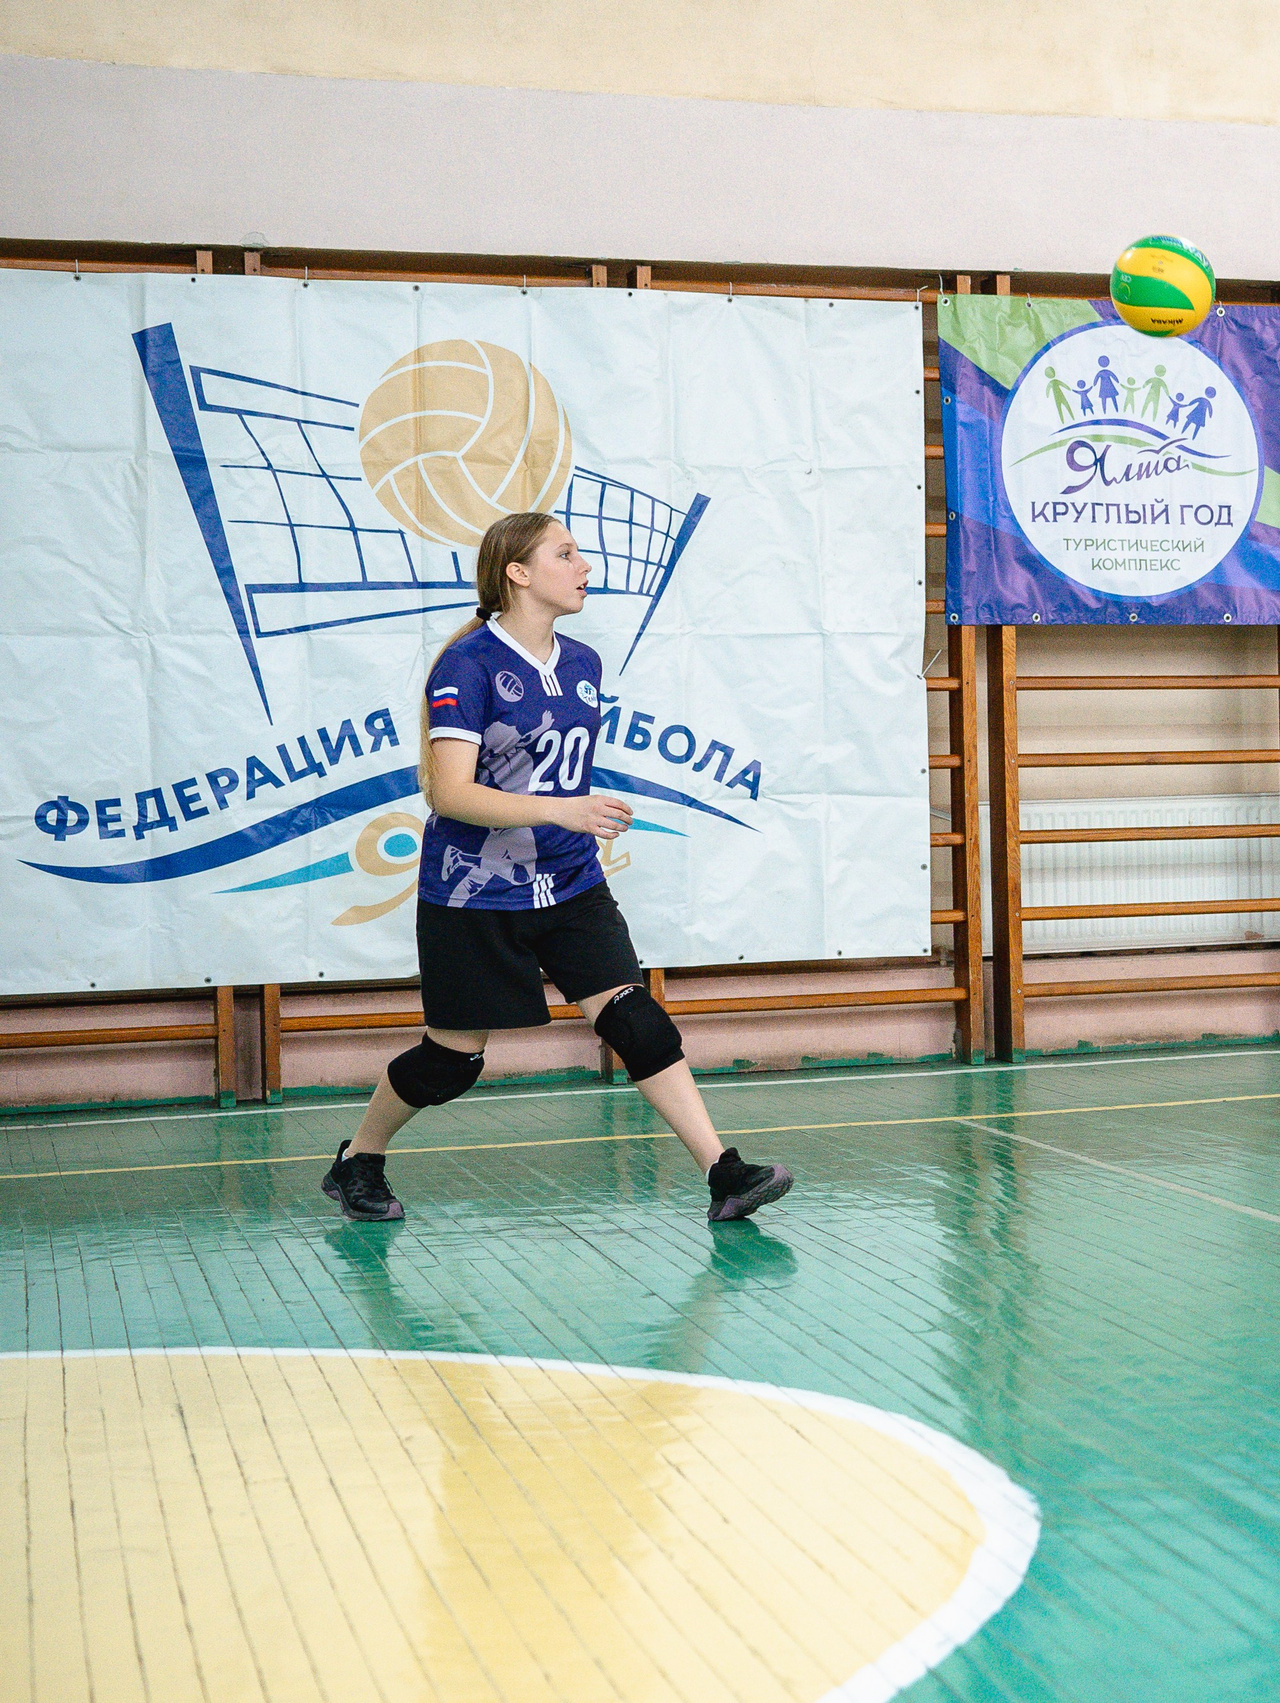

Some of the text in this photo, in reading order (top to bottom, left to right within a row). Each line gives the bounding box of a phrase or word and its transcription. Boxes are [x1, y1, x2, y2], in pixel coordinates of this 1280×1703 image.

[1059, 439, 1190, 495] Ялта
[1030, 498, 1234, 527] КРУГЛЫЙ ГОД
[1063, 537, 1205, 552] ТУРИСТИЧЕСКИЙ
[1091, 557, 1181, 571] КОМПЛЕКС
[34, 708, 401, 842] ФЕДЕРАЦИЯ
[527, 726, 590, 792] 20
